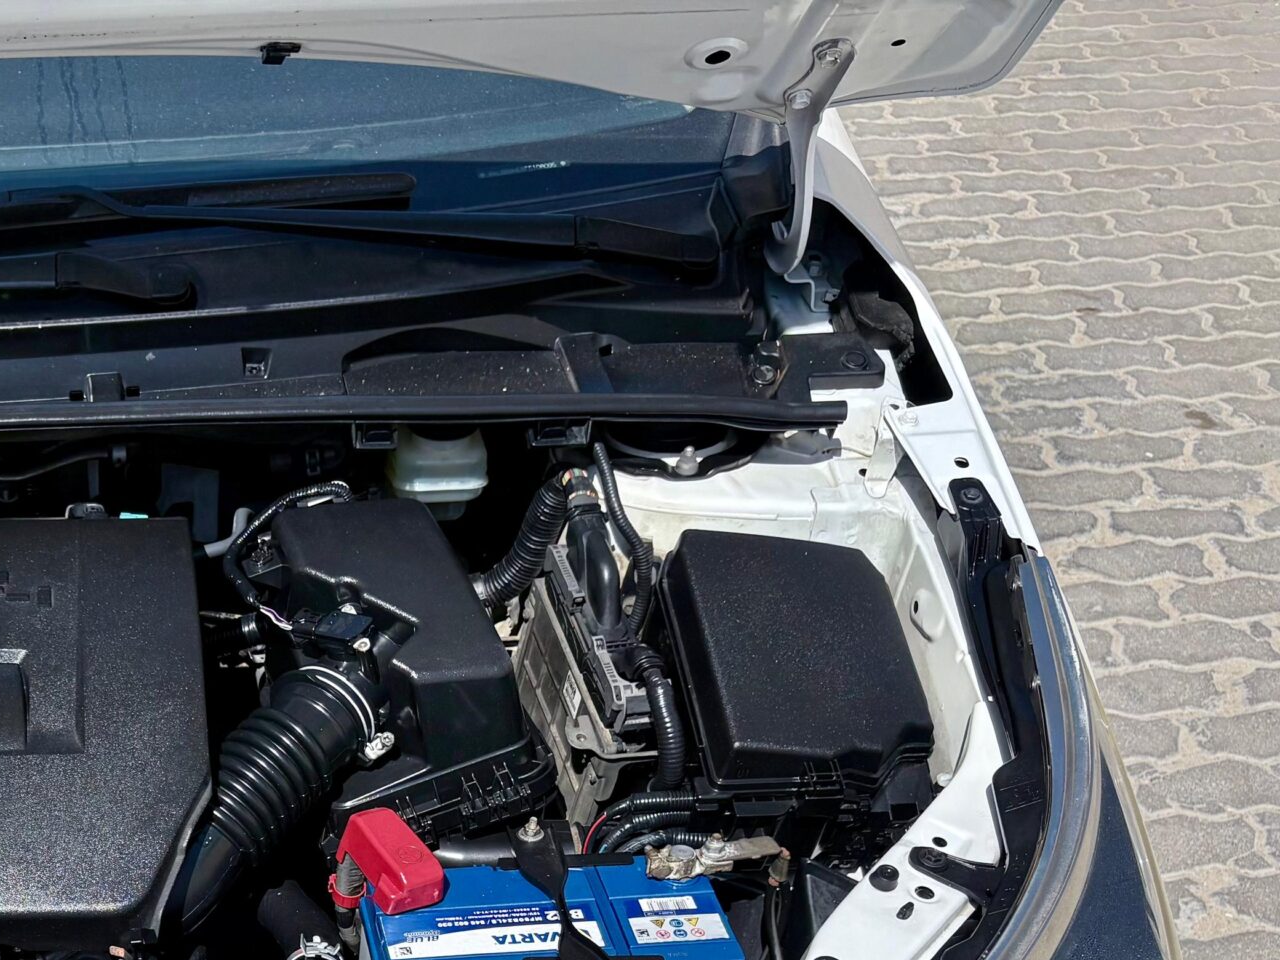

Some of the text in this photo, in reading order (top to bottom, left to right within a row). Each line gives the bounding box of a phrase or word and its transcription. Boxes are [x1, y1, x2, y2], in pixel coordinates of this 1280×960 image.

[545, 909, 585, 921] B2
[406, 935, 439, 944] BLUE
[491, 931, 560, 945] VARTA
